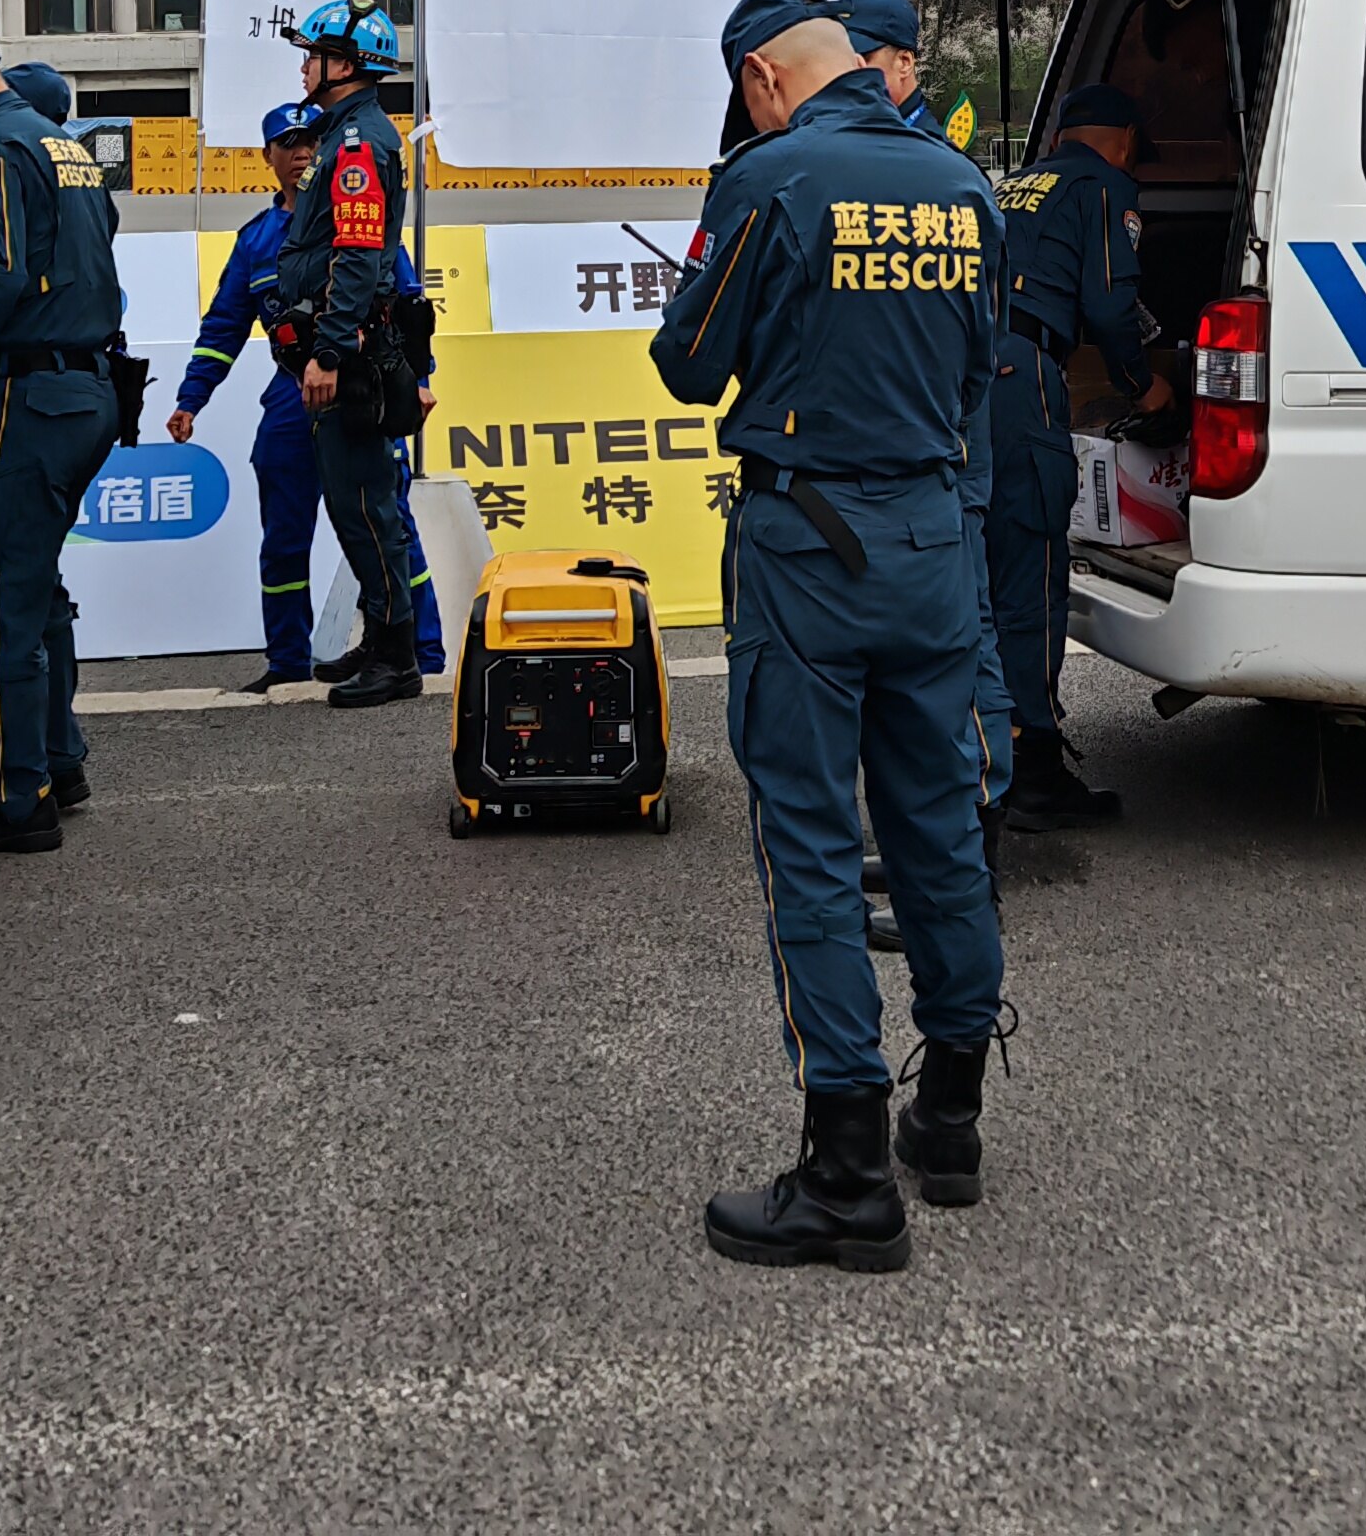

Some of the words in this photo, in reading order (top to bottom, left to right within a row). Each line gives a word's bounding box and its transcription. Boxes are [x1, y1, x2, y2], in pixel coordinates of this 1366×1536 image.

[830, 201, 982, 250] 蓝天救援
[831, 251, 982, 293] RESCUE
[75, 474, 194, 526] 蓓盾
